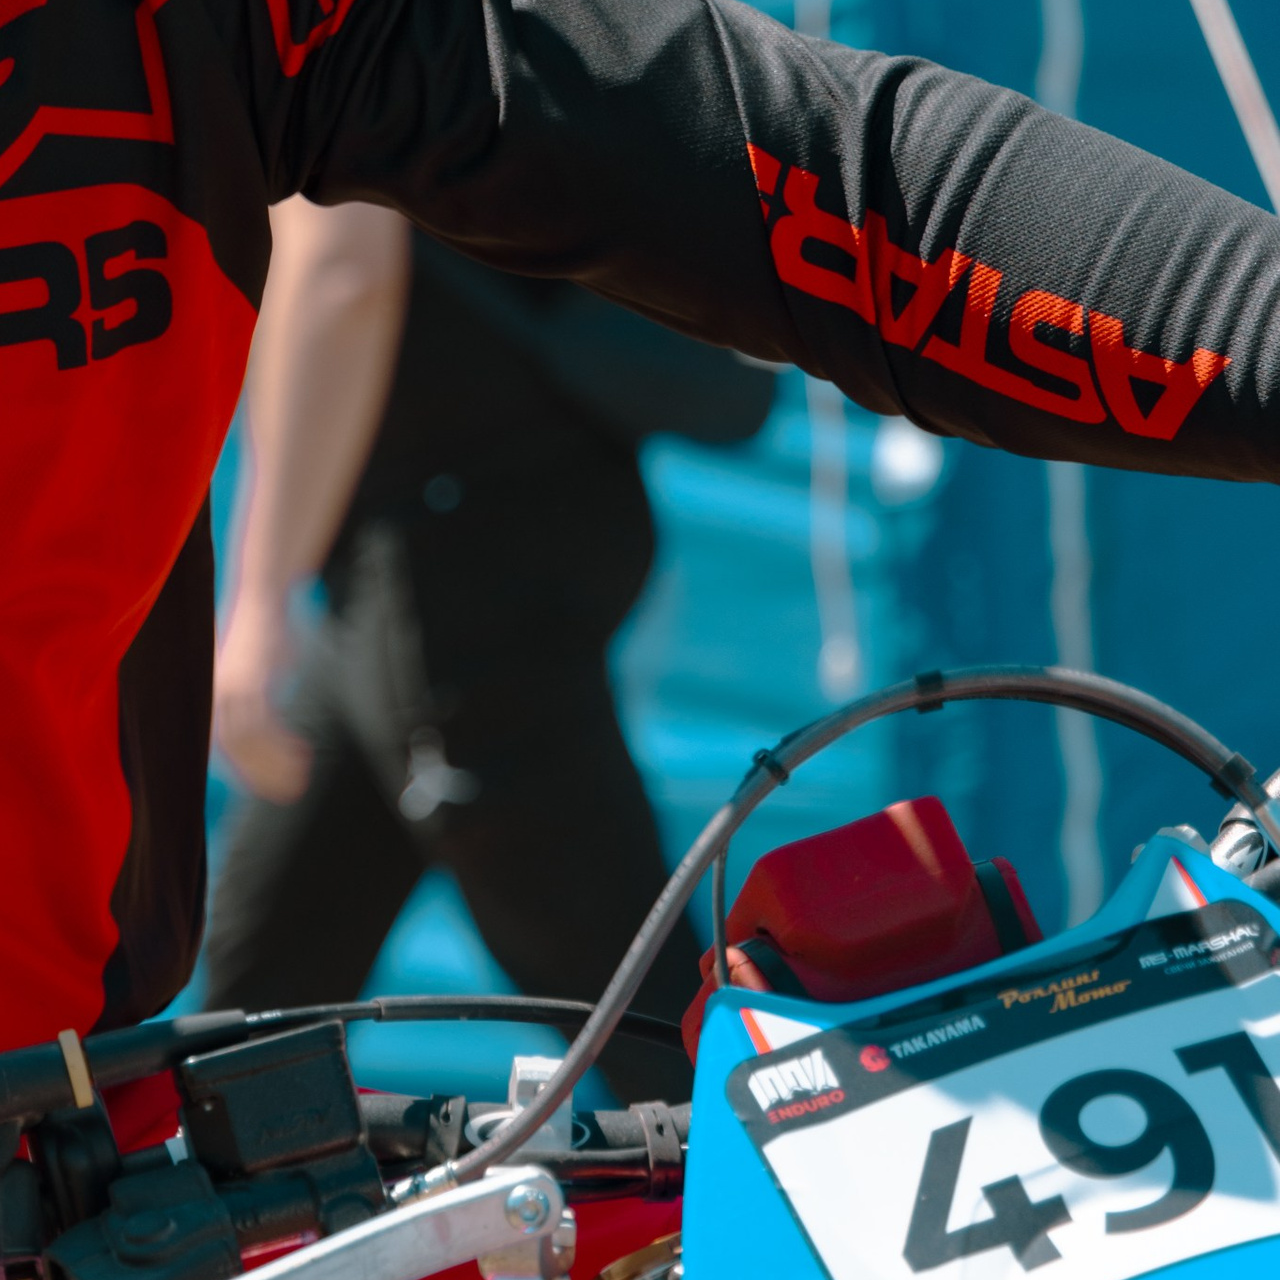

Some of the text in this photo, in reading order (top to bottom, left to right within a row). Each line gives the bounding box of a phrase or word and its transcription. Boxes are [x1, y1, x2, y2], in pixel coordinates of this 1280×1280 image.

[889, 1014, 986, 1059] TAKAYAMA
[766, 1088, 846, 1125] ENDURO
[902, 1030, 1280, 1274] 491
